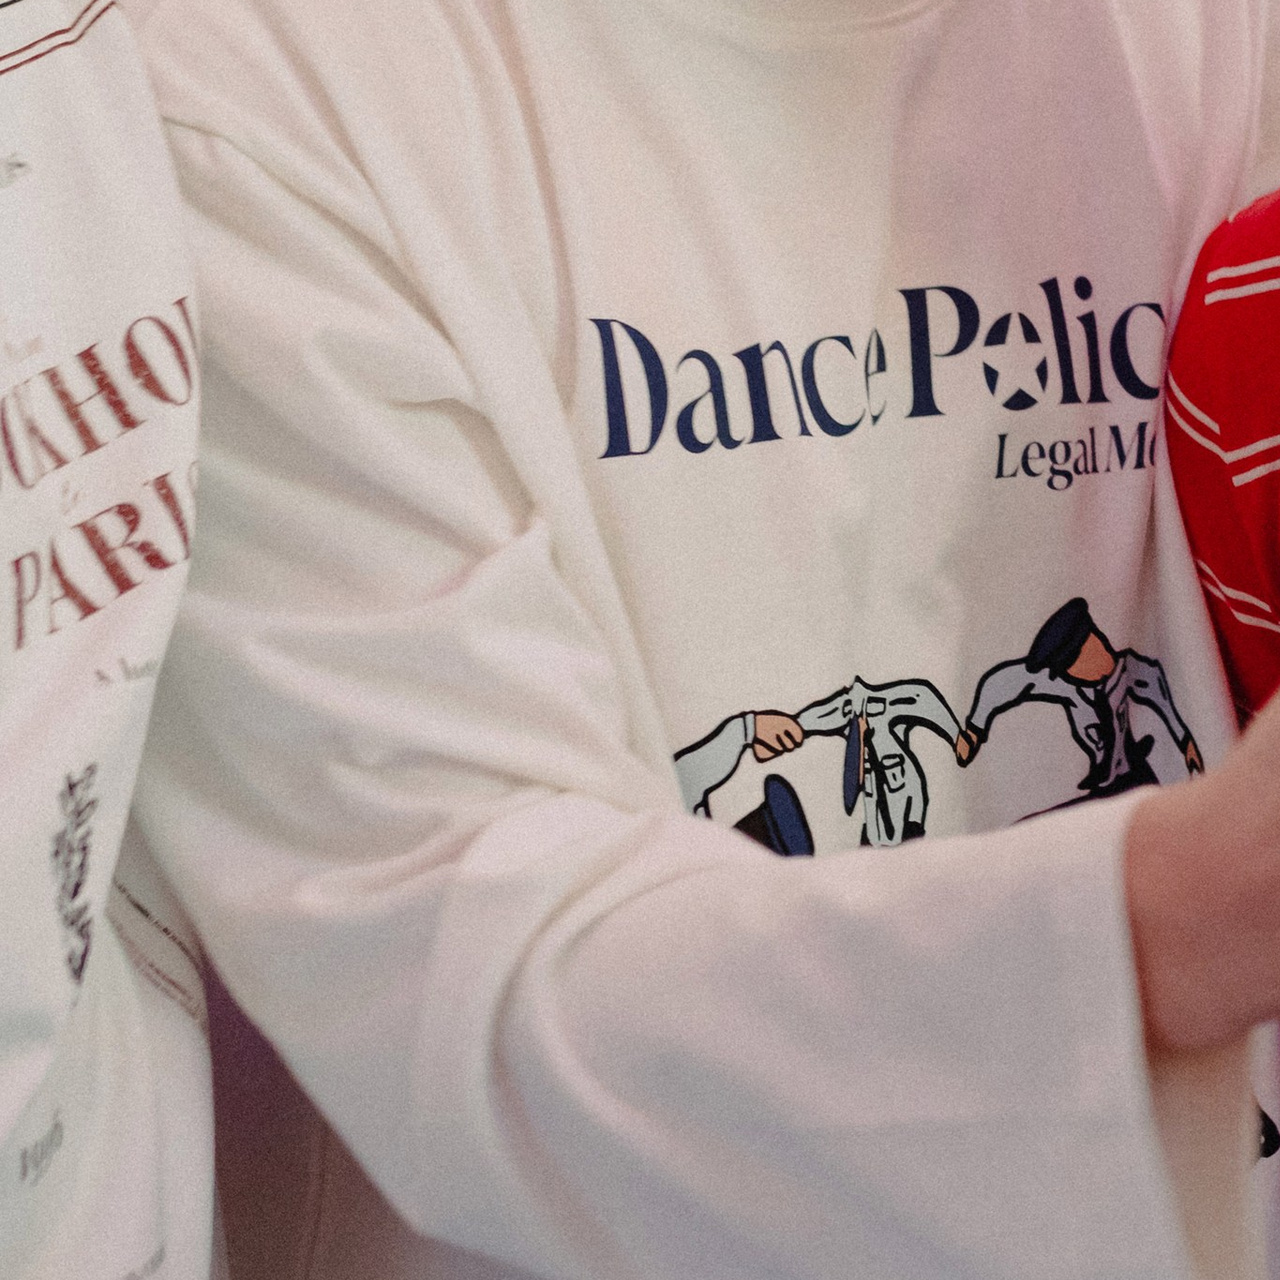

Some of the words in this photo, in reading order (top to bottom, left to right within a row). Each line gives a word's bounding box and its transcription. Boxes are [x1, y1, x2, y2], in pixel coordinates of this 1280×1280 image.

[588, 318, 887, 459] Dance
[995, 426, 1099, 491] Legal
[9, 461, 198, 650] PARI
